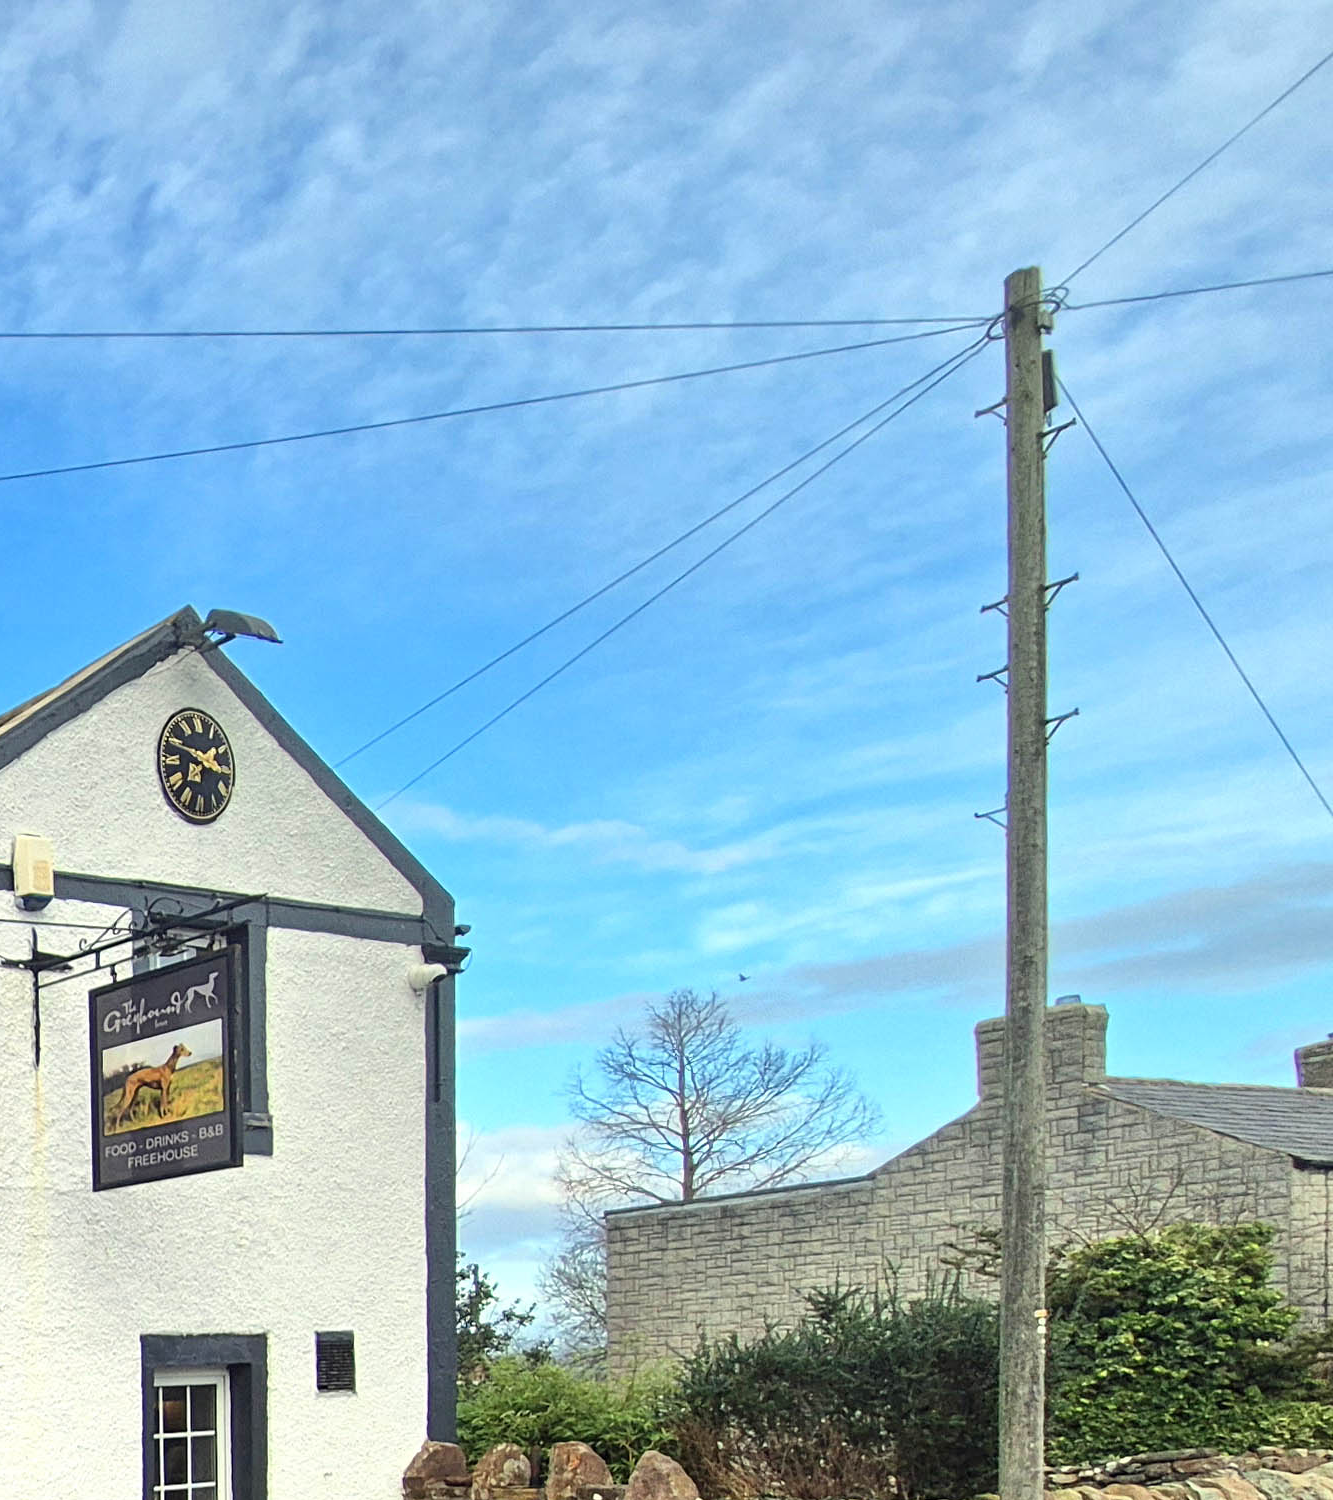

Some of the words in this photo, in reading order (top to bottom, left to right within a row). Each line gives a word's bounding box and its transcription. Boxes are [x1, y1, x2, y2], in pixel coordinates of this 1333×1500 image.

[103, 991, 181, 1034] Greyhound
[105, 1141, 137, 1158] FOOD
[145, 1130, 190, 1150] DRINKS
[198, 1123, 224, 1140] B&B
[127, 1144, 198, 1168] FREEHOUSE
